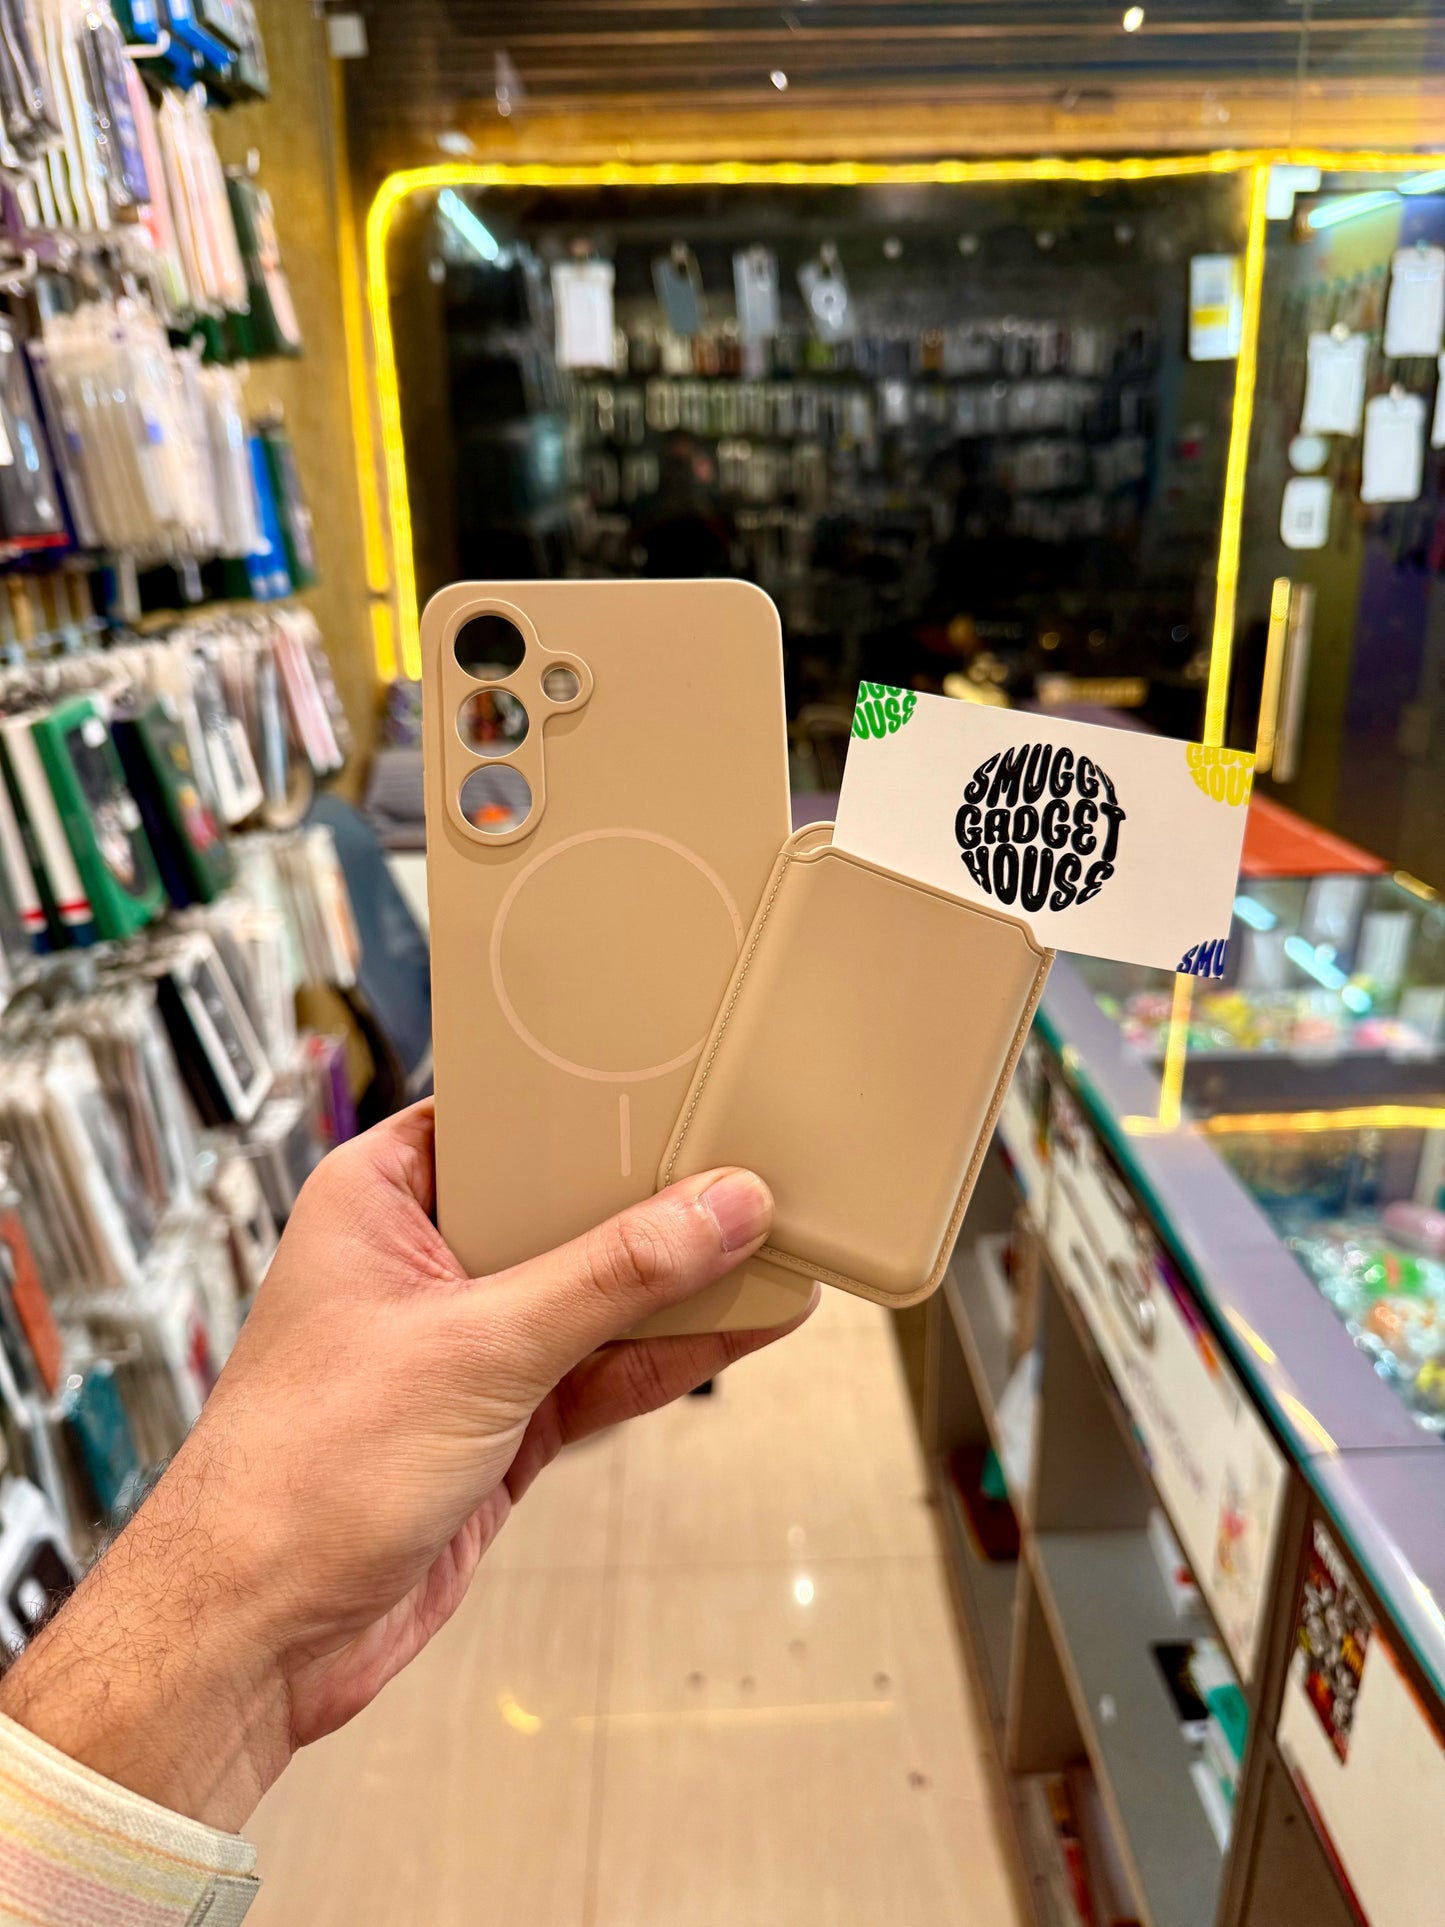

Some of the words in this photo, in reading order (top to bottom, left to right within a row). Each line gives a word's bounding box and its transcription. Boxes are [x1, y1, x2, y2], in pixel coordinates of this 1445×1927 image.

[851, 694, 917, 740] OUSE
[955, 798, 1126, 862] GADGET
[961, 843, 1115, 912] HOUSE
